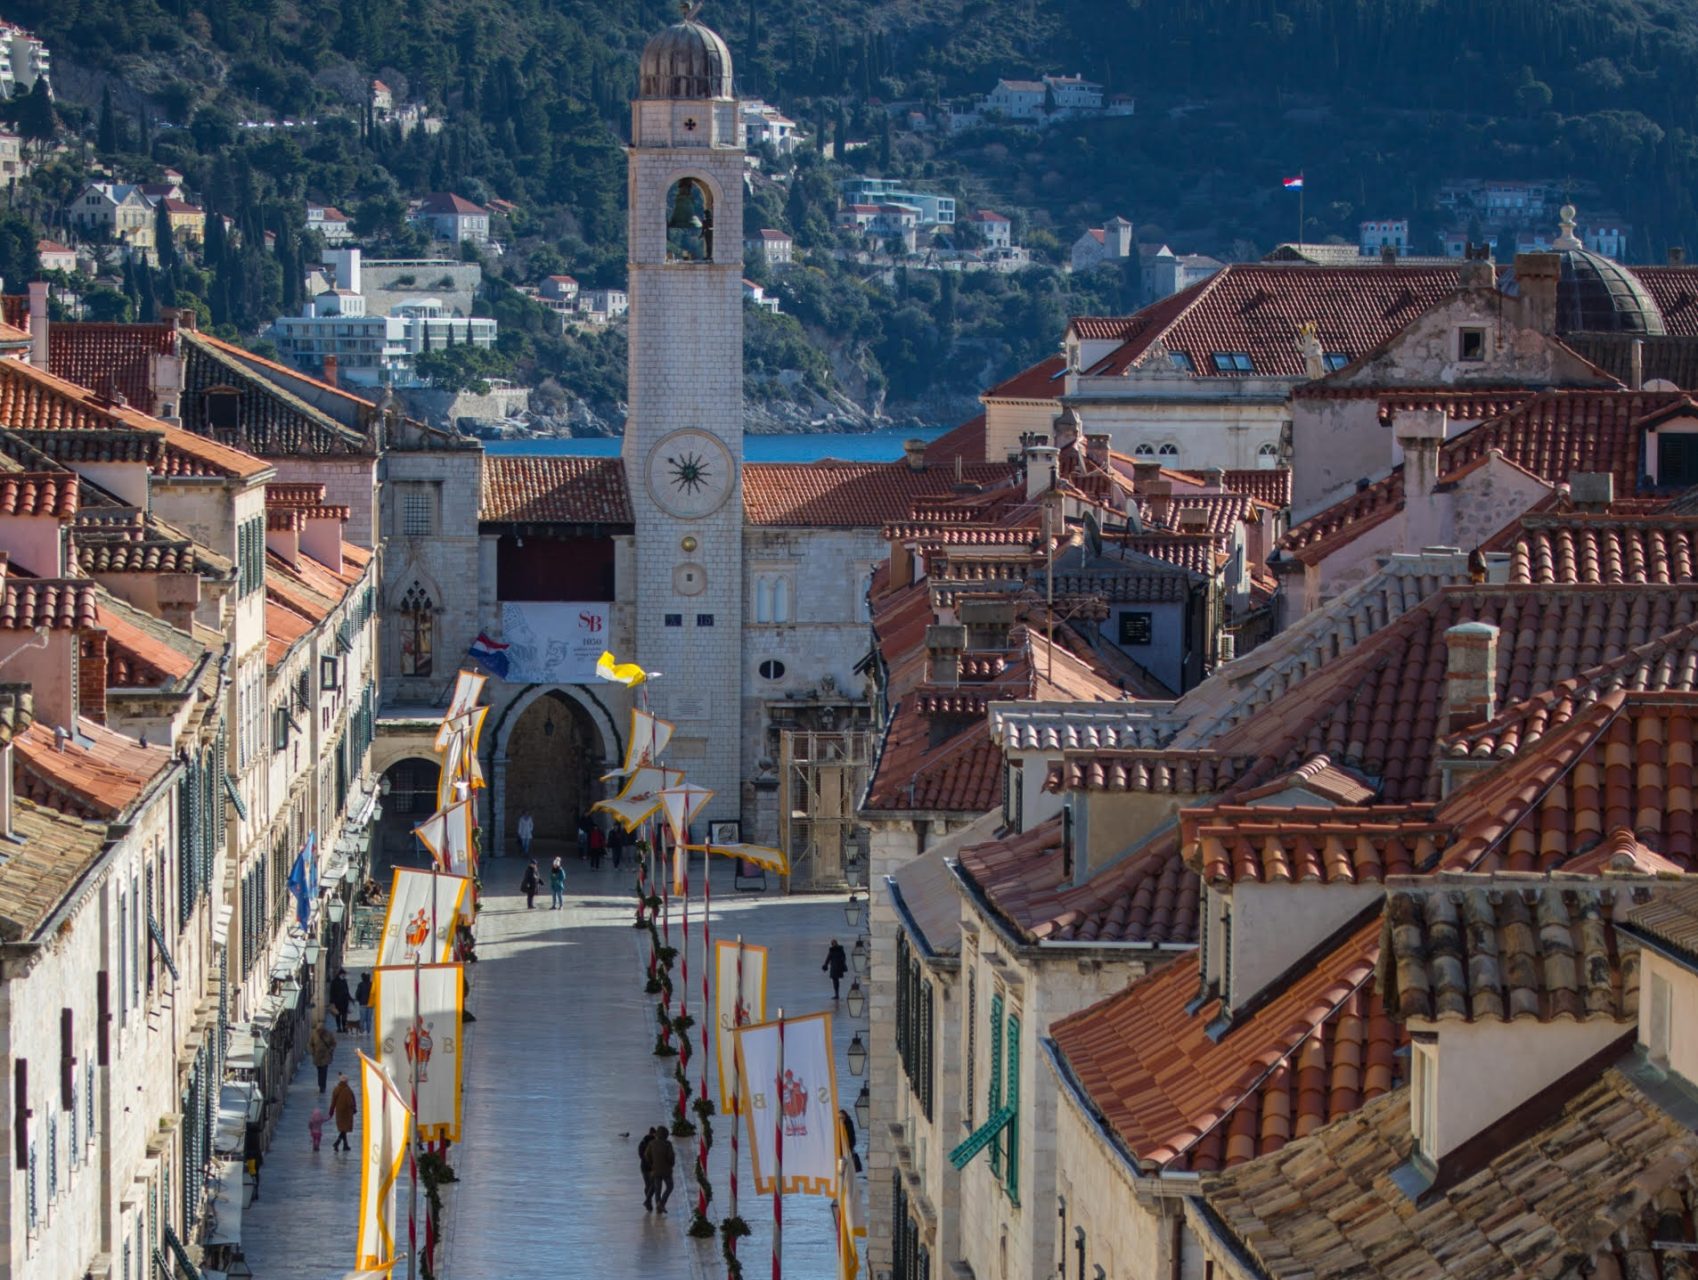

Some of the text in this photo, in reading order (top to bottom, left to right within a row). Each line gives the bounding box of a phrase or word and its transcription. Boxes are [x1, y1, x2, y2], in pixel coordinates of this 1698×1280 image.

[578, 610, 602, 632] SB
[456, 849, 465, 863] B
[383, 1037, 455, 1054] S B
